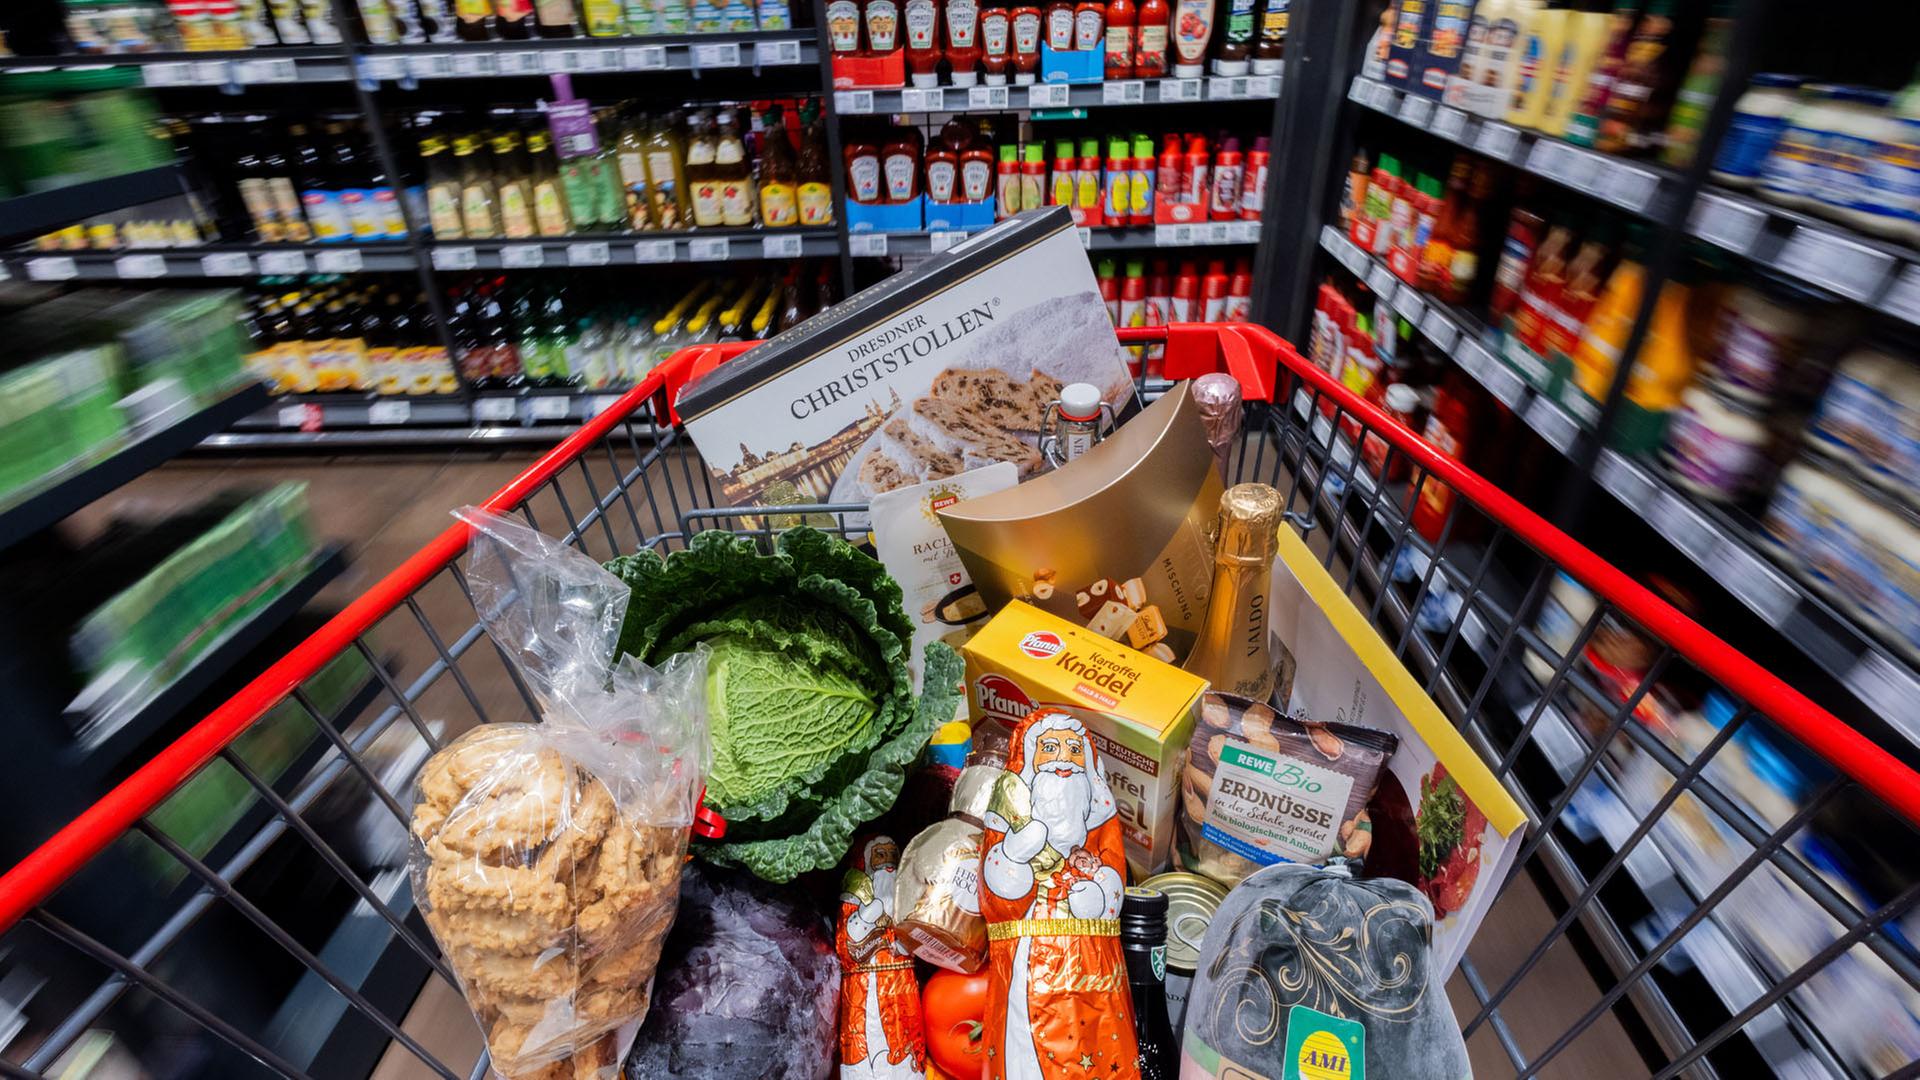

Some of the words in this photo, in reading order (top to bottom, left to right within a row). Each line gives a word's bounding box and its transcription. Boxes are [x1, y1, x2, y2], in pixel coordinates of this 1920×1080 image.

[847, 314, 928, 363] DRESDNER
[934, 497, 955, 508] REWE
[913, 537, 952, 555] RACL
[1162, 558, 1192, 621] MISCHUNG
[1023, 633, 1064, 654] Pfanni
[1247, 594, 1263, 657] VALDO
[1056, 651, 1134, 698] Knödel
[1089, 651, 1142, 682] Kartoffel
[974, 683, 1033, 718] Pfann
[1109, 741, 1156, 767] DEUTSCHE
[1109, 748, 1155, 774] KARTOFFELN
[1237, 753, 1273, 773] REWE
[1273, 763, 1322, 793] Bio
[1215, 797, 1228, 807] in
[1228, 799, 1244, 814] der
[1284, 824, 1327, 844] geröstet
[1219, 778, 1334, 829] ERDNÜSSE
[1212, 807, 1227, 822] Aus
[1228, 815, 1289, 844] biologischem
[1048, 950, 1123, 993] Lindt
[1303, 1050, 1347, 1073] AMI
